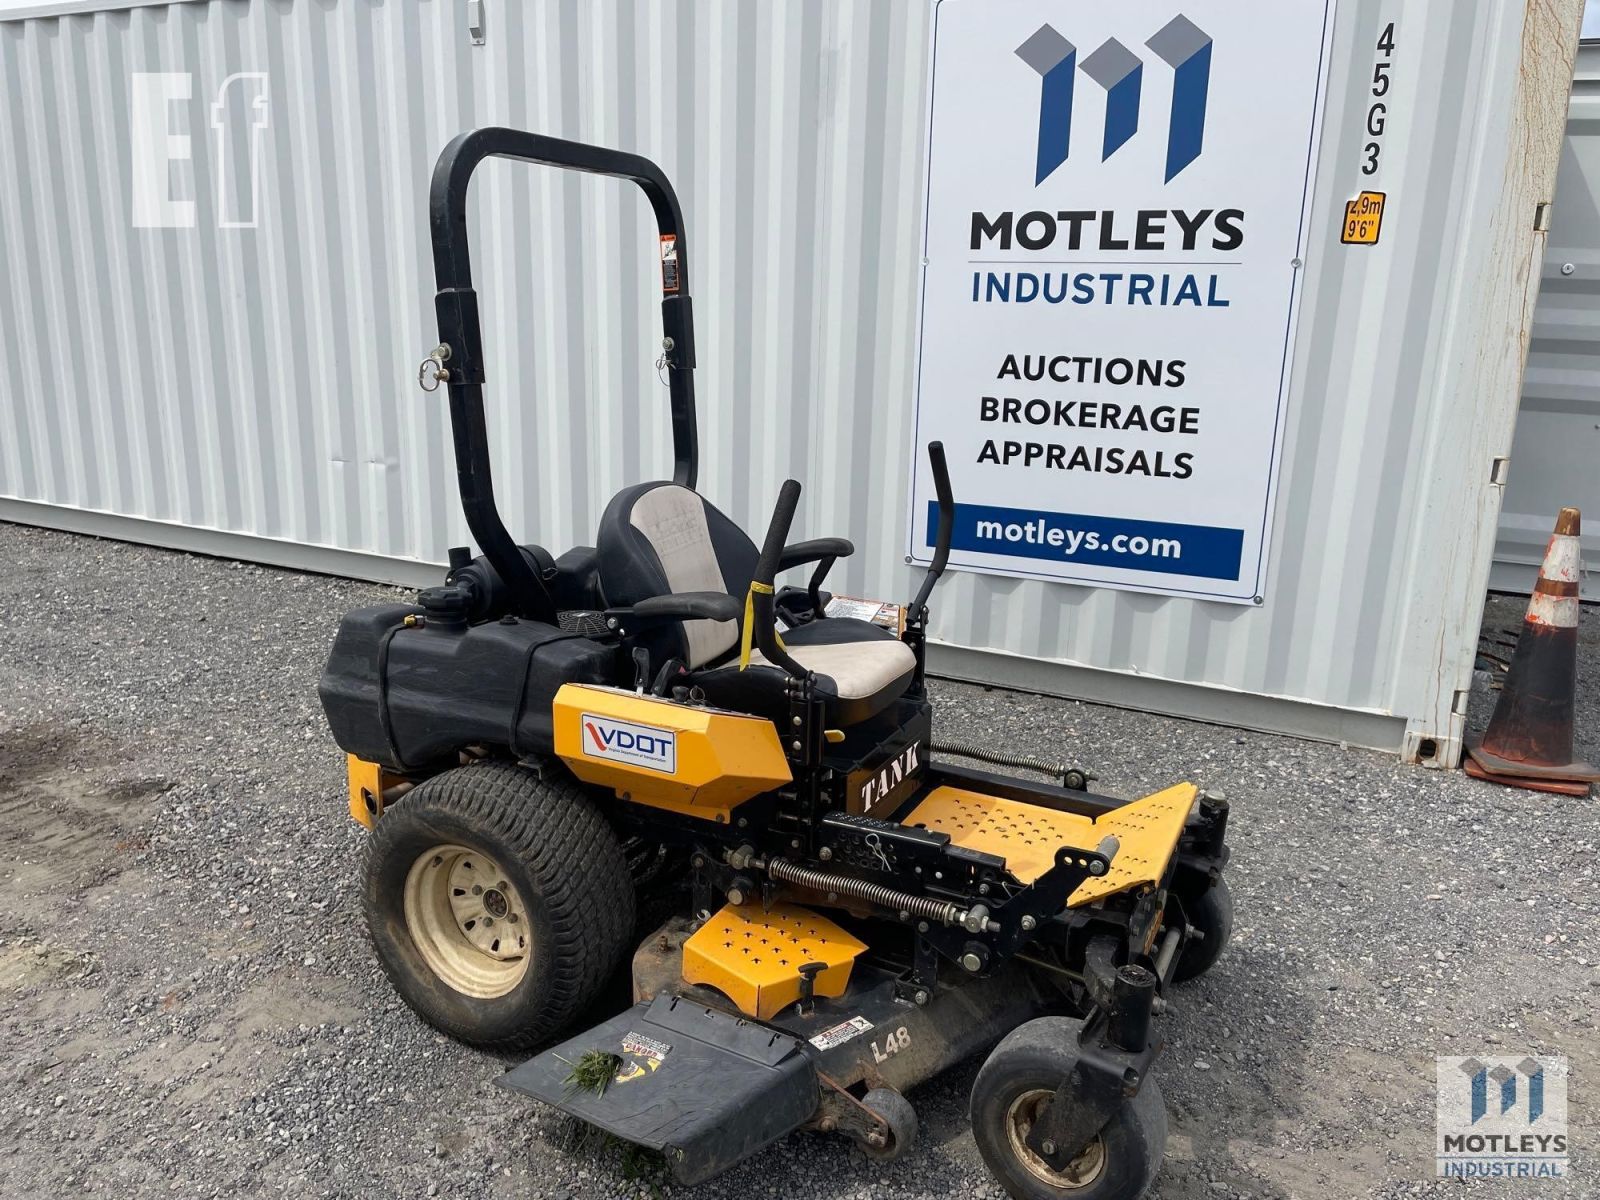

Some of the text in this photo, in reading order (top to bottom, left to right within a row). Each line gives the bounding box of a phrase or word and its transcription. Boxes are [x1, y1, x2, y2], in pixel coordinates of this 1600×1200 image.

[970, 209, 1245, 251] MOTLEYS
[972, 272, 1231, 307] INDUSTRIAL
[997, 354, 1187, 388] AUCTIONS
[980, 396, 1200, 434] BROKERAGE
[977, 439, 1195, 479] APPRAISALS
[976, 519, 1182, 559] motleys.com
[598, 727, 672, 757] VDOT
[861, 739, 920, 813] TANK
[870, 1026, 911, 1064] L48
